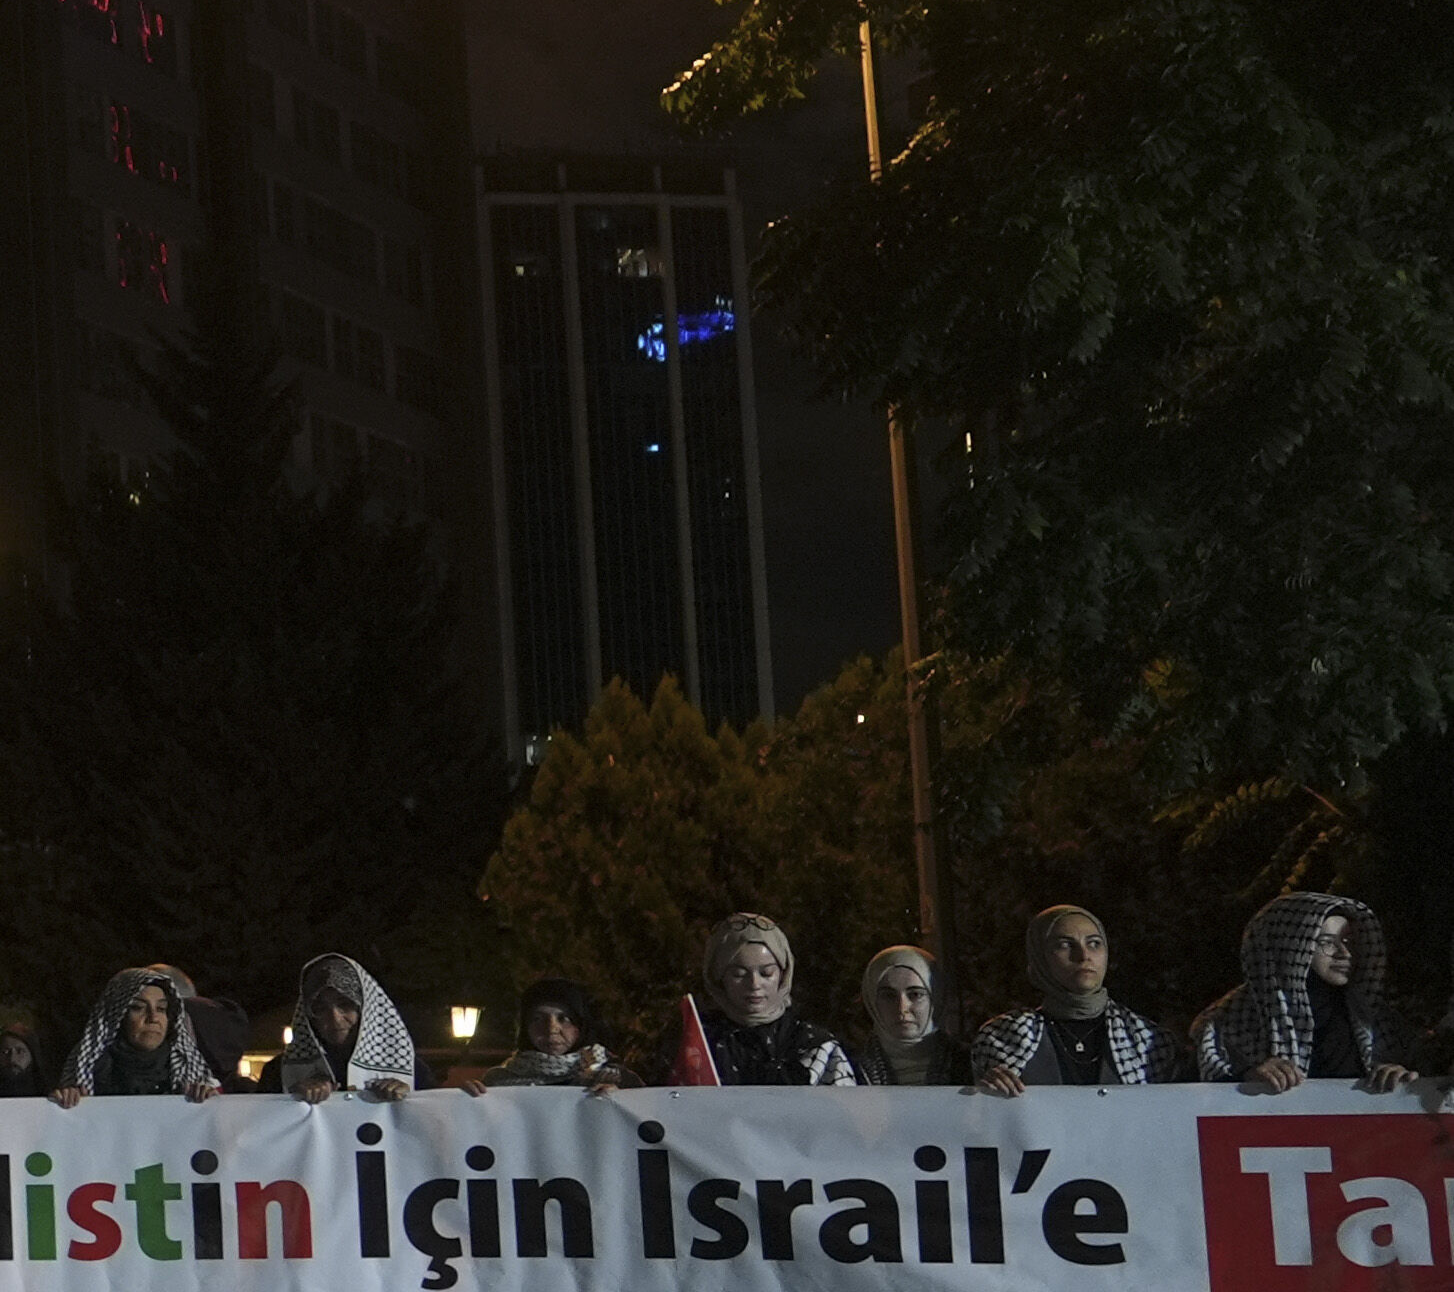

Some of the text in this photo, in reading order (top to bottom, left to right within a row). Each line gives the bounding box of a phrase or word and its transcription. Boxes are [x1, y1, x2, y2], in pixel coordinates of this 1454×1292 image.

[355, 1122, 595, 1291] İçin
[637, 1120, 1129, 1266] İsrail'e
[1239, 1146, 1454, 1268] Ta
